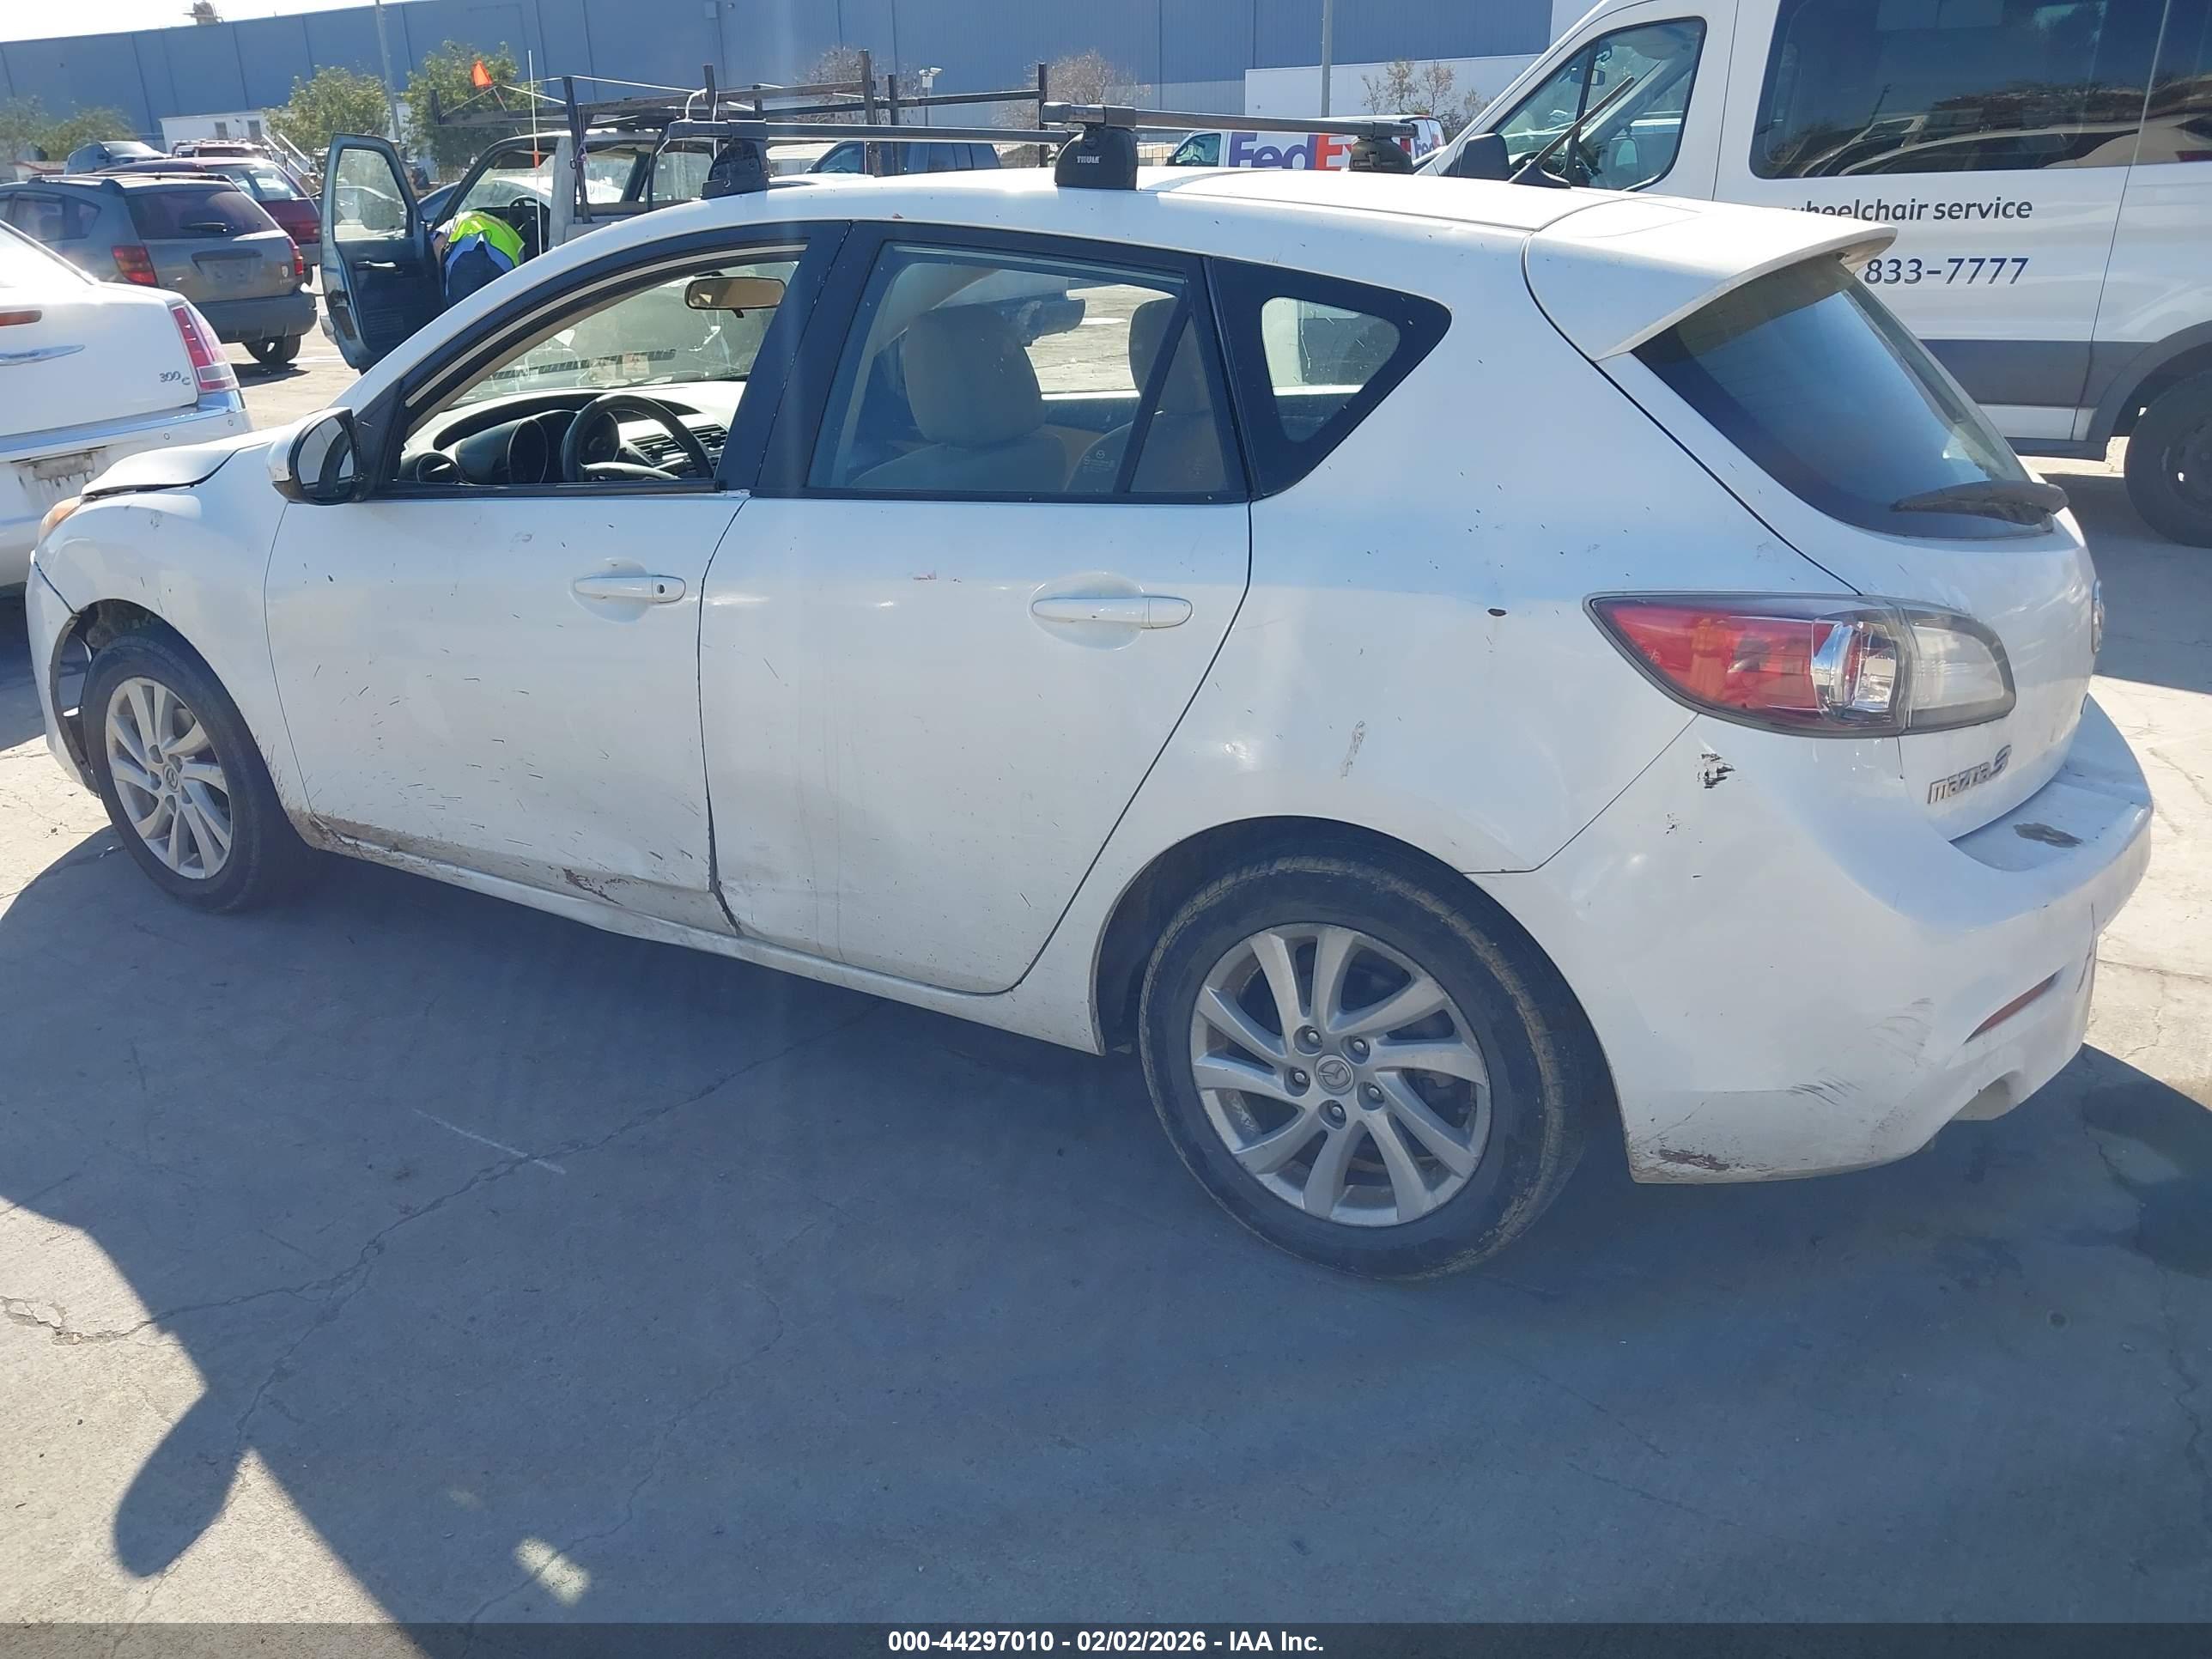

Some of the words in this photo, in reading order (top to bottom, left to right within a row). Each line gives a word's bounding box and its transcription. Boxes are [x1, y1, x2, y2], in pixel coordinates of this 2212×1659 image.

[1229, 131, 1352, 170] FedE
[1784, 198, 1928, 221] heelchair
[1932, 196, 2033, 220] service
[1863, 258, 2029, 285] 833-7777
